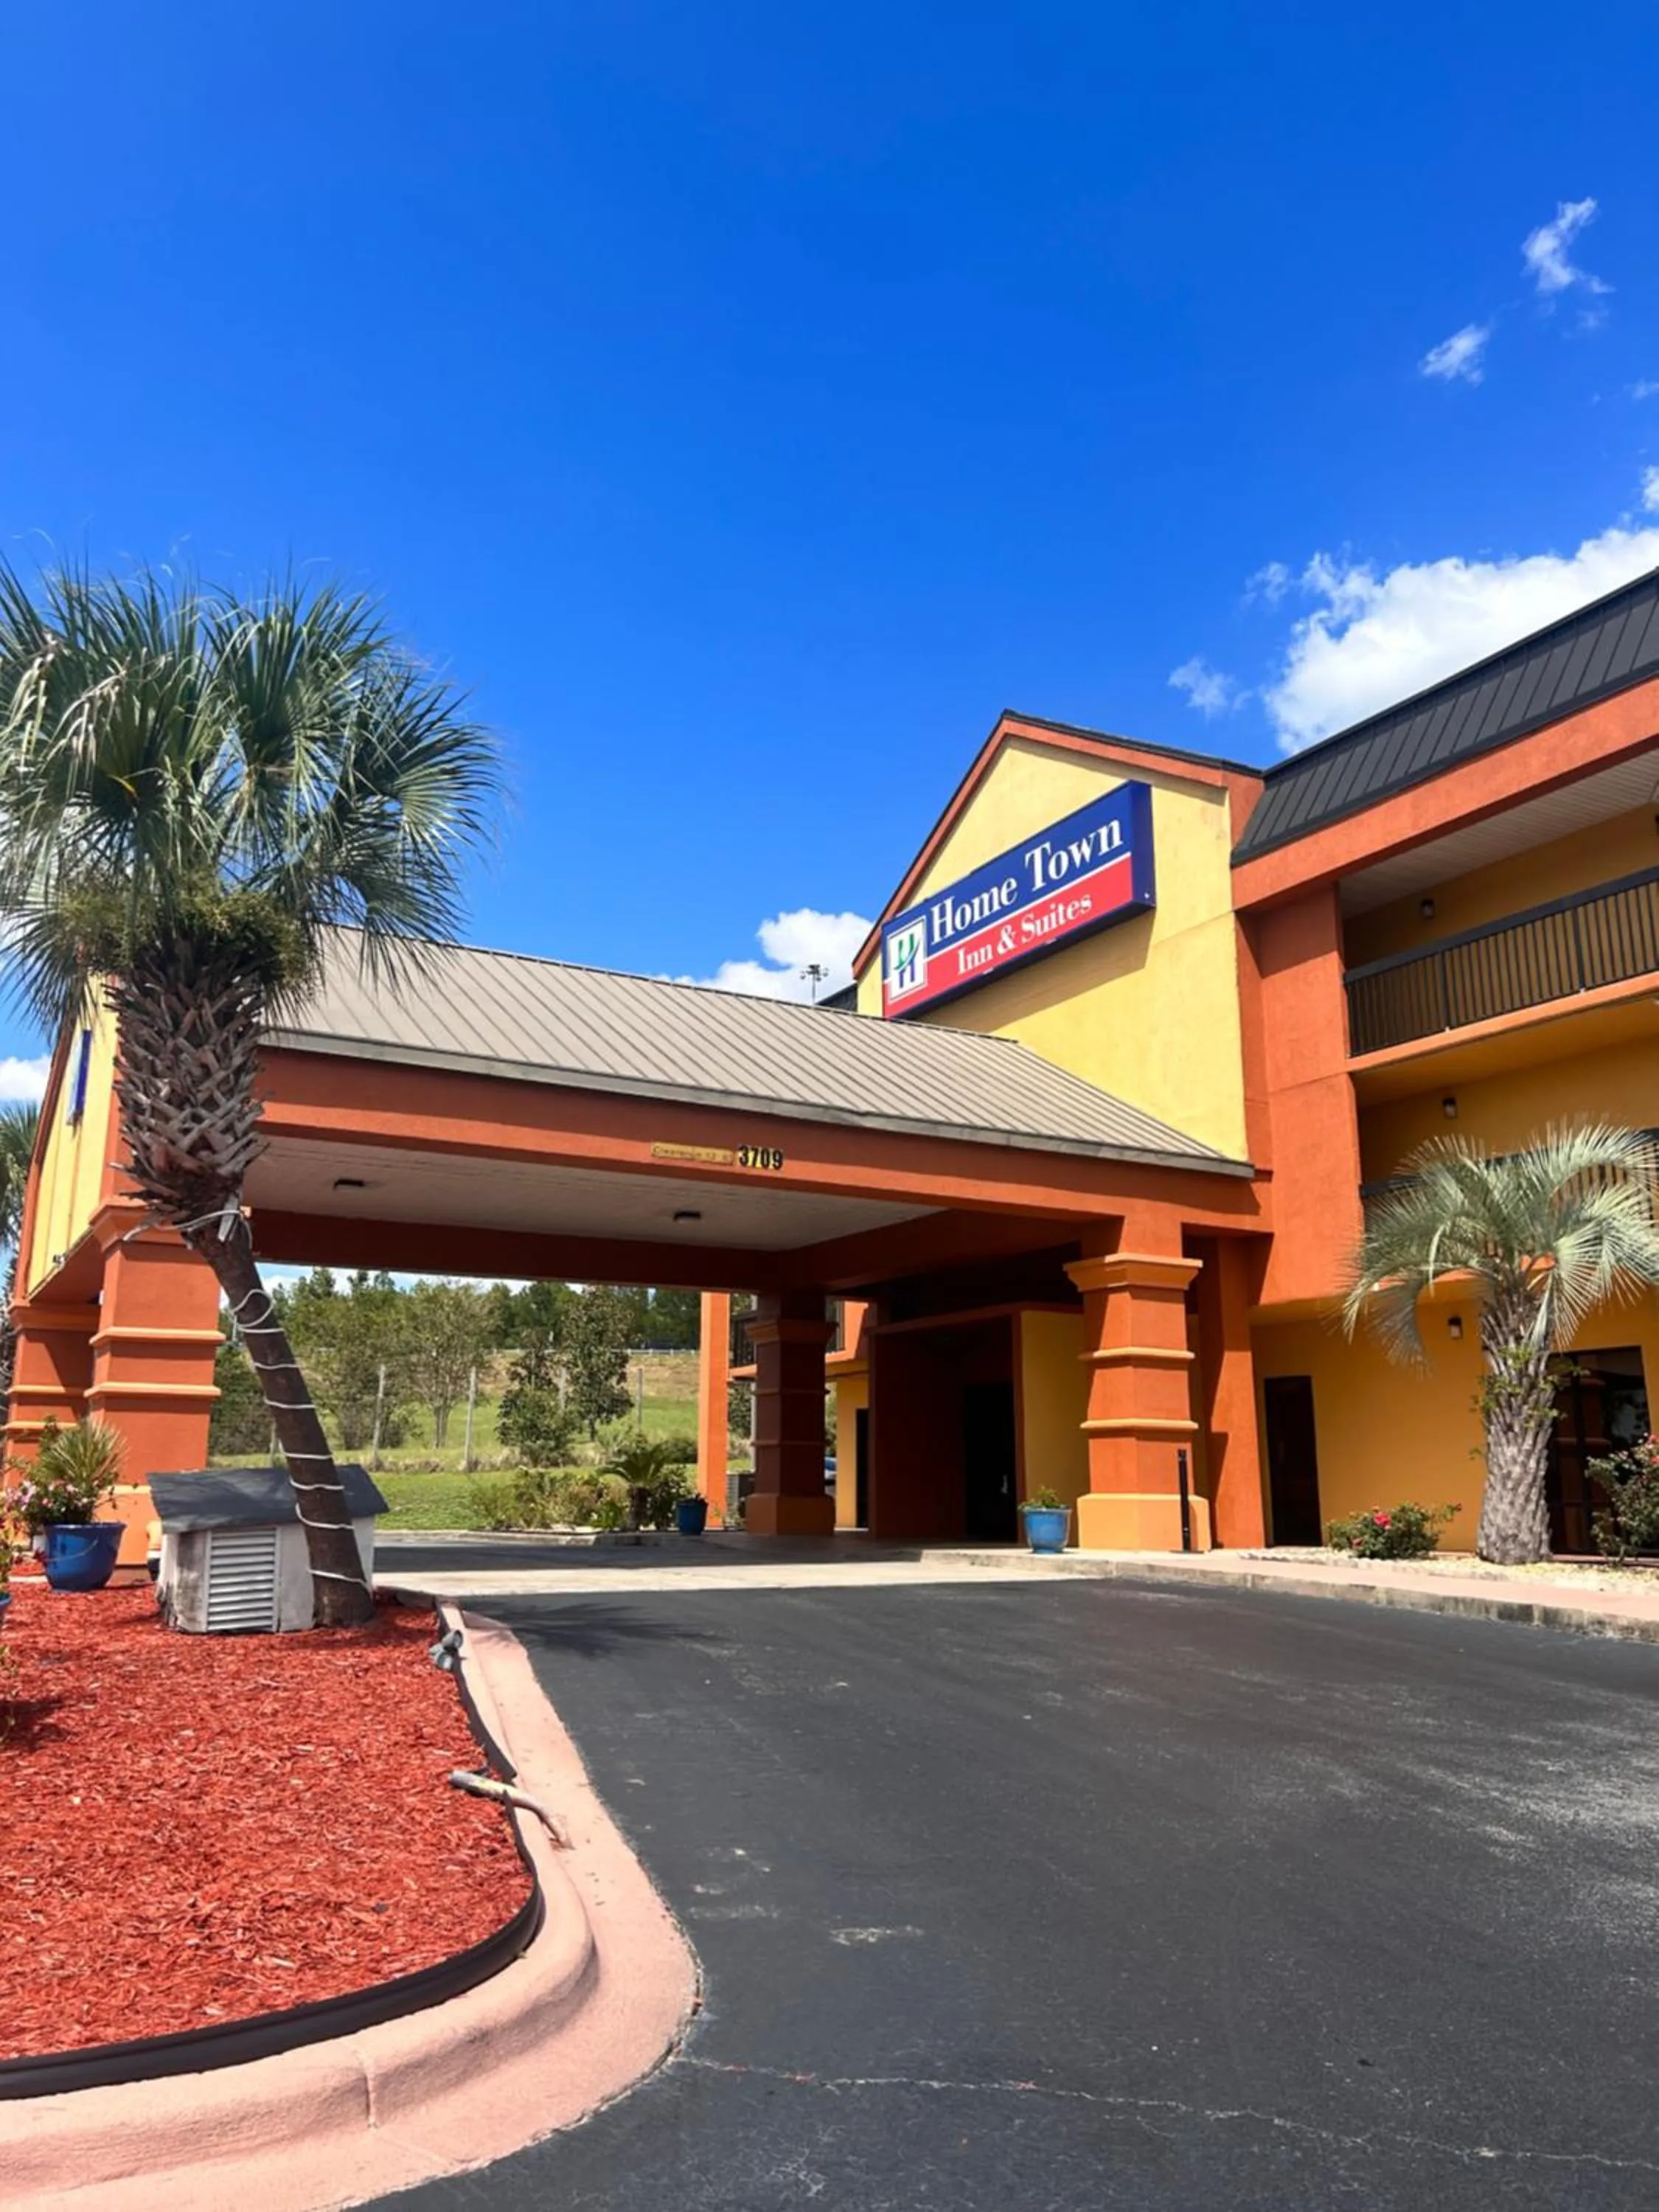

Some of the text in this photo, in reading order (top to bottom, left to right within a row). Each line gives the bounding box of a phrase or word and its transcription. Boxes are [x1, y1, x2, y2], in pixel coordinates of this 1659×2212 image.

[931, 818, 1124, 946] Home Town
[957, 893, 1093, 975] Inn & Suites
[739, 1145, 783, 1170] 3709
